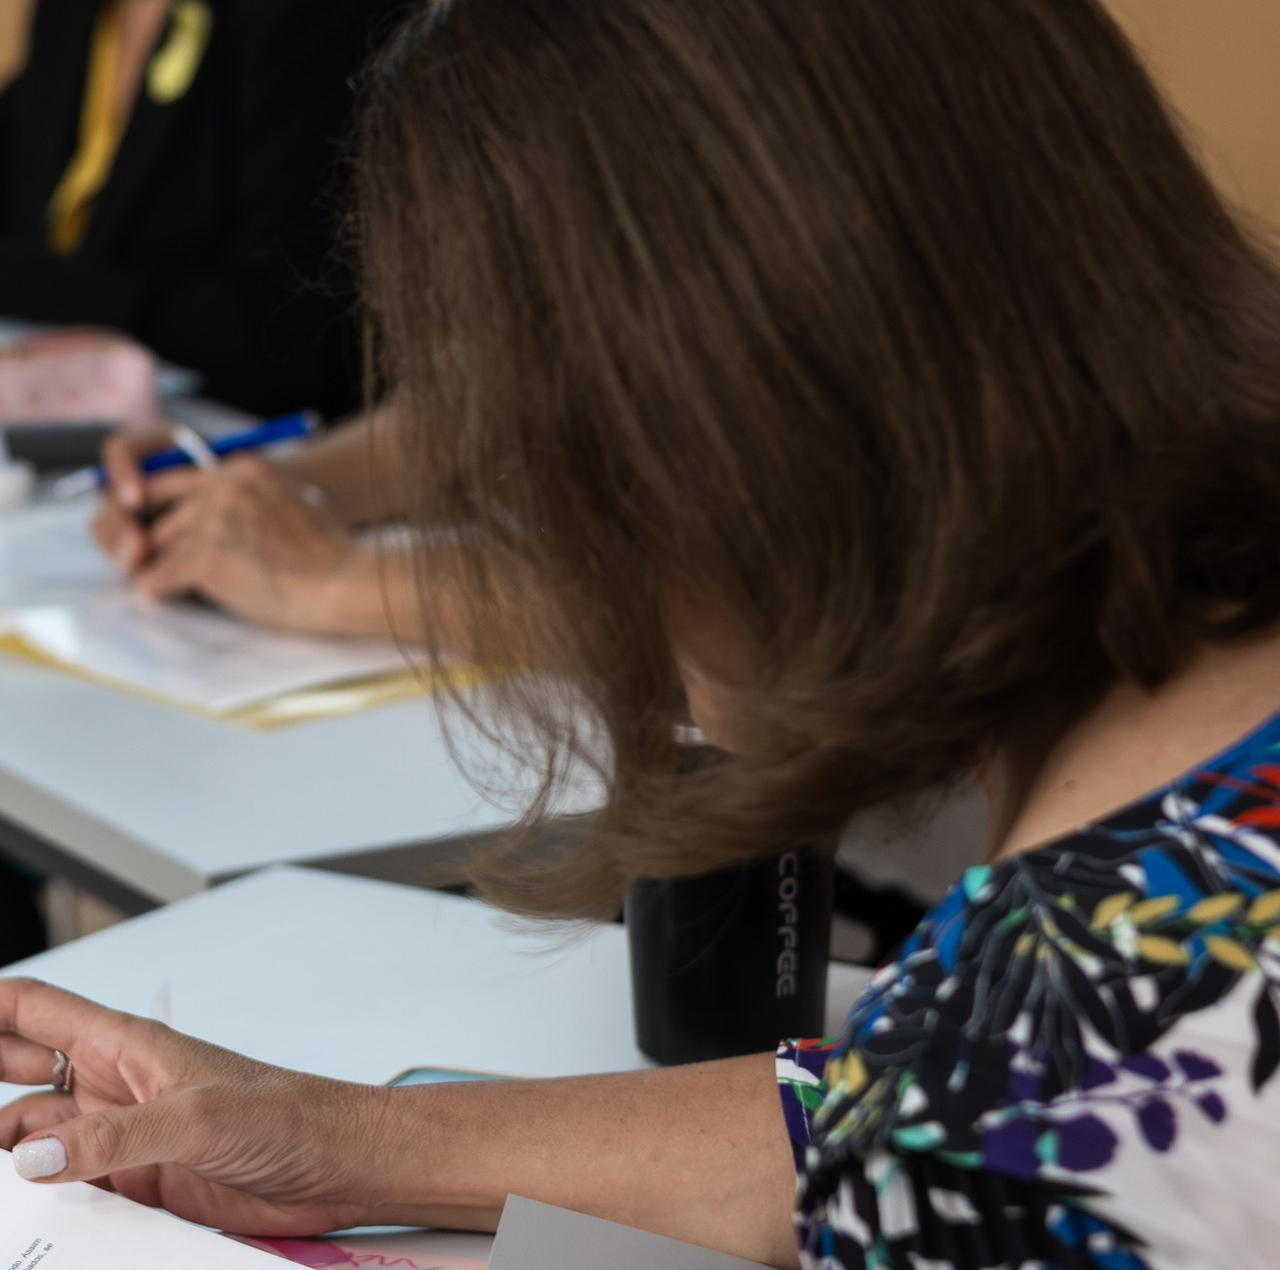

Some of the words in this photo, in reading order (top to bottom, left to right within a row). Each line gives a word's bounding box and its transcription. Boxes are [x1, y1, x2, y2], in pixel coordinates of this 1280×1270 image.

[777, 852, 799, 998] COFFEE
[20, 1238, 42, 1258] Assim
[43, 1242, 54, 1251] se
